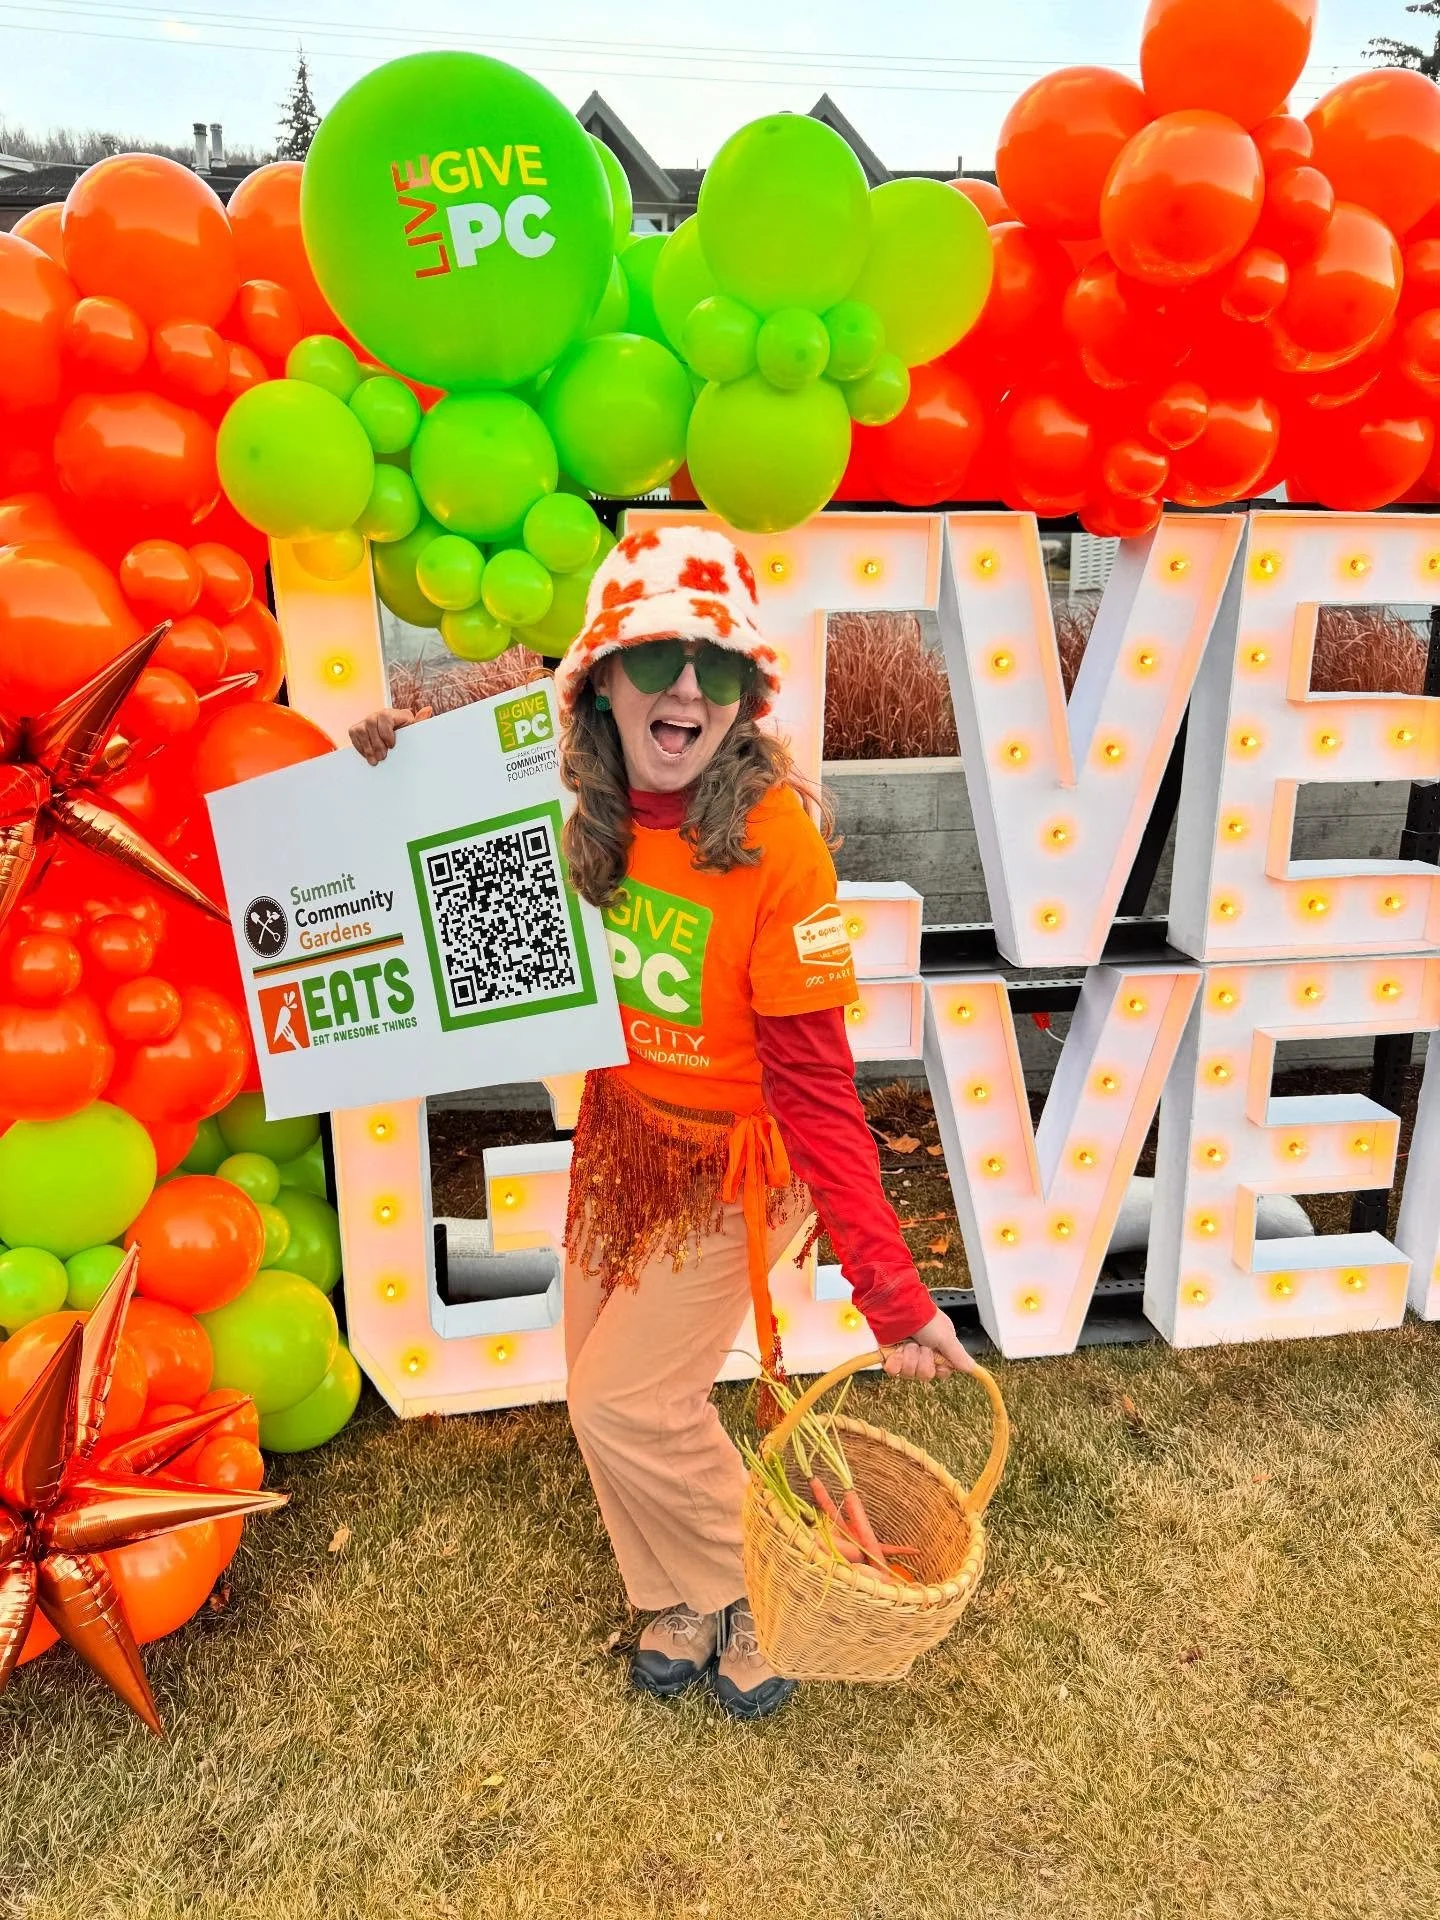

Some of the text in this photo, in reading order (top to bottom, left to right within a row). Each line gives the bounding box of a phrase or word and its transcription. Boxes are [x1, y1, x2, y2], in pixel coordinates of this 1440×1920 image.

[430, 144, 548, 194] GIVE
[391, 153, 452, 279] LIVE
[446, 194, 557, 269] PC
[511, 695, 546, 719] GIVE
[498, 707, 516, 751] LIVE
[514, 713, 551, 745] PC
[506, 748, 557, 772] COMMUNITY
[507, 759, 560, 782] FOUNDATION
[290, 873, 356, 906] Summit
[295, 889, 394, 928] Community
[607, 886, 699, 955] GIVE
[299, 921, 372, 950] Gardens
[301, 957, 415, 1032] EATS
[312, 1016, 418, 1047] EAT AWESOME THINGS
[630, 1020, 705, 1052] CITY
[629, 1045, 711, 1068] OUNDATION
